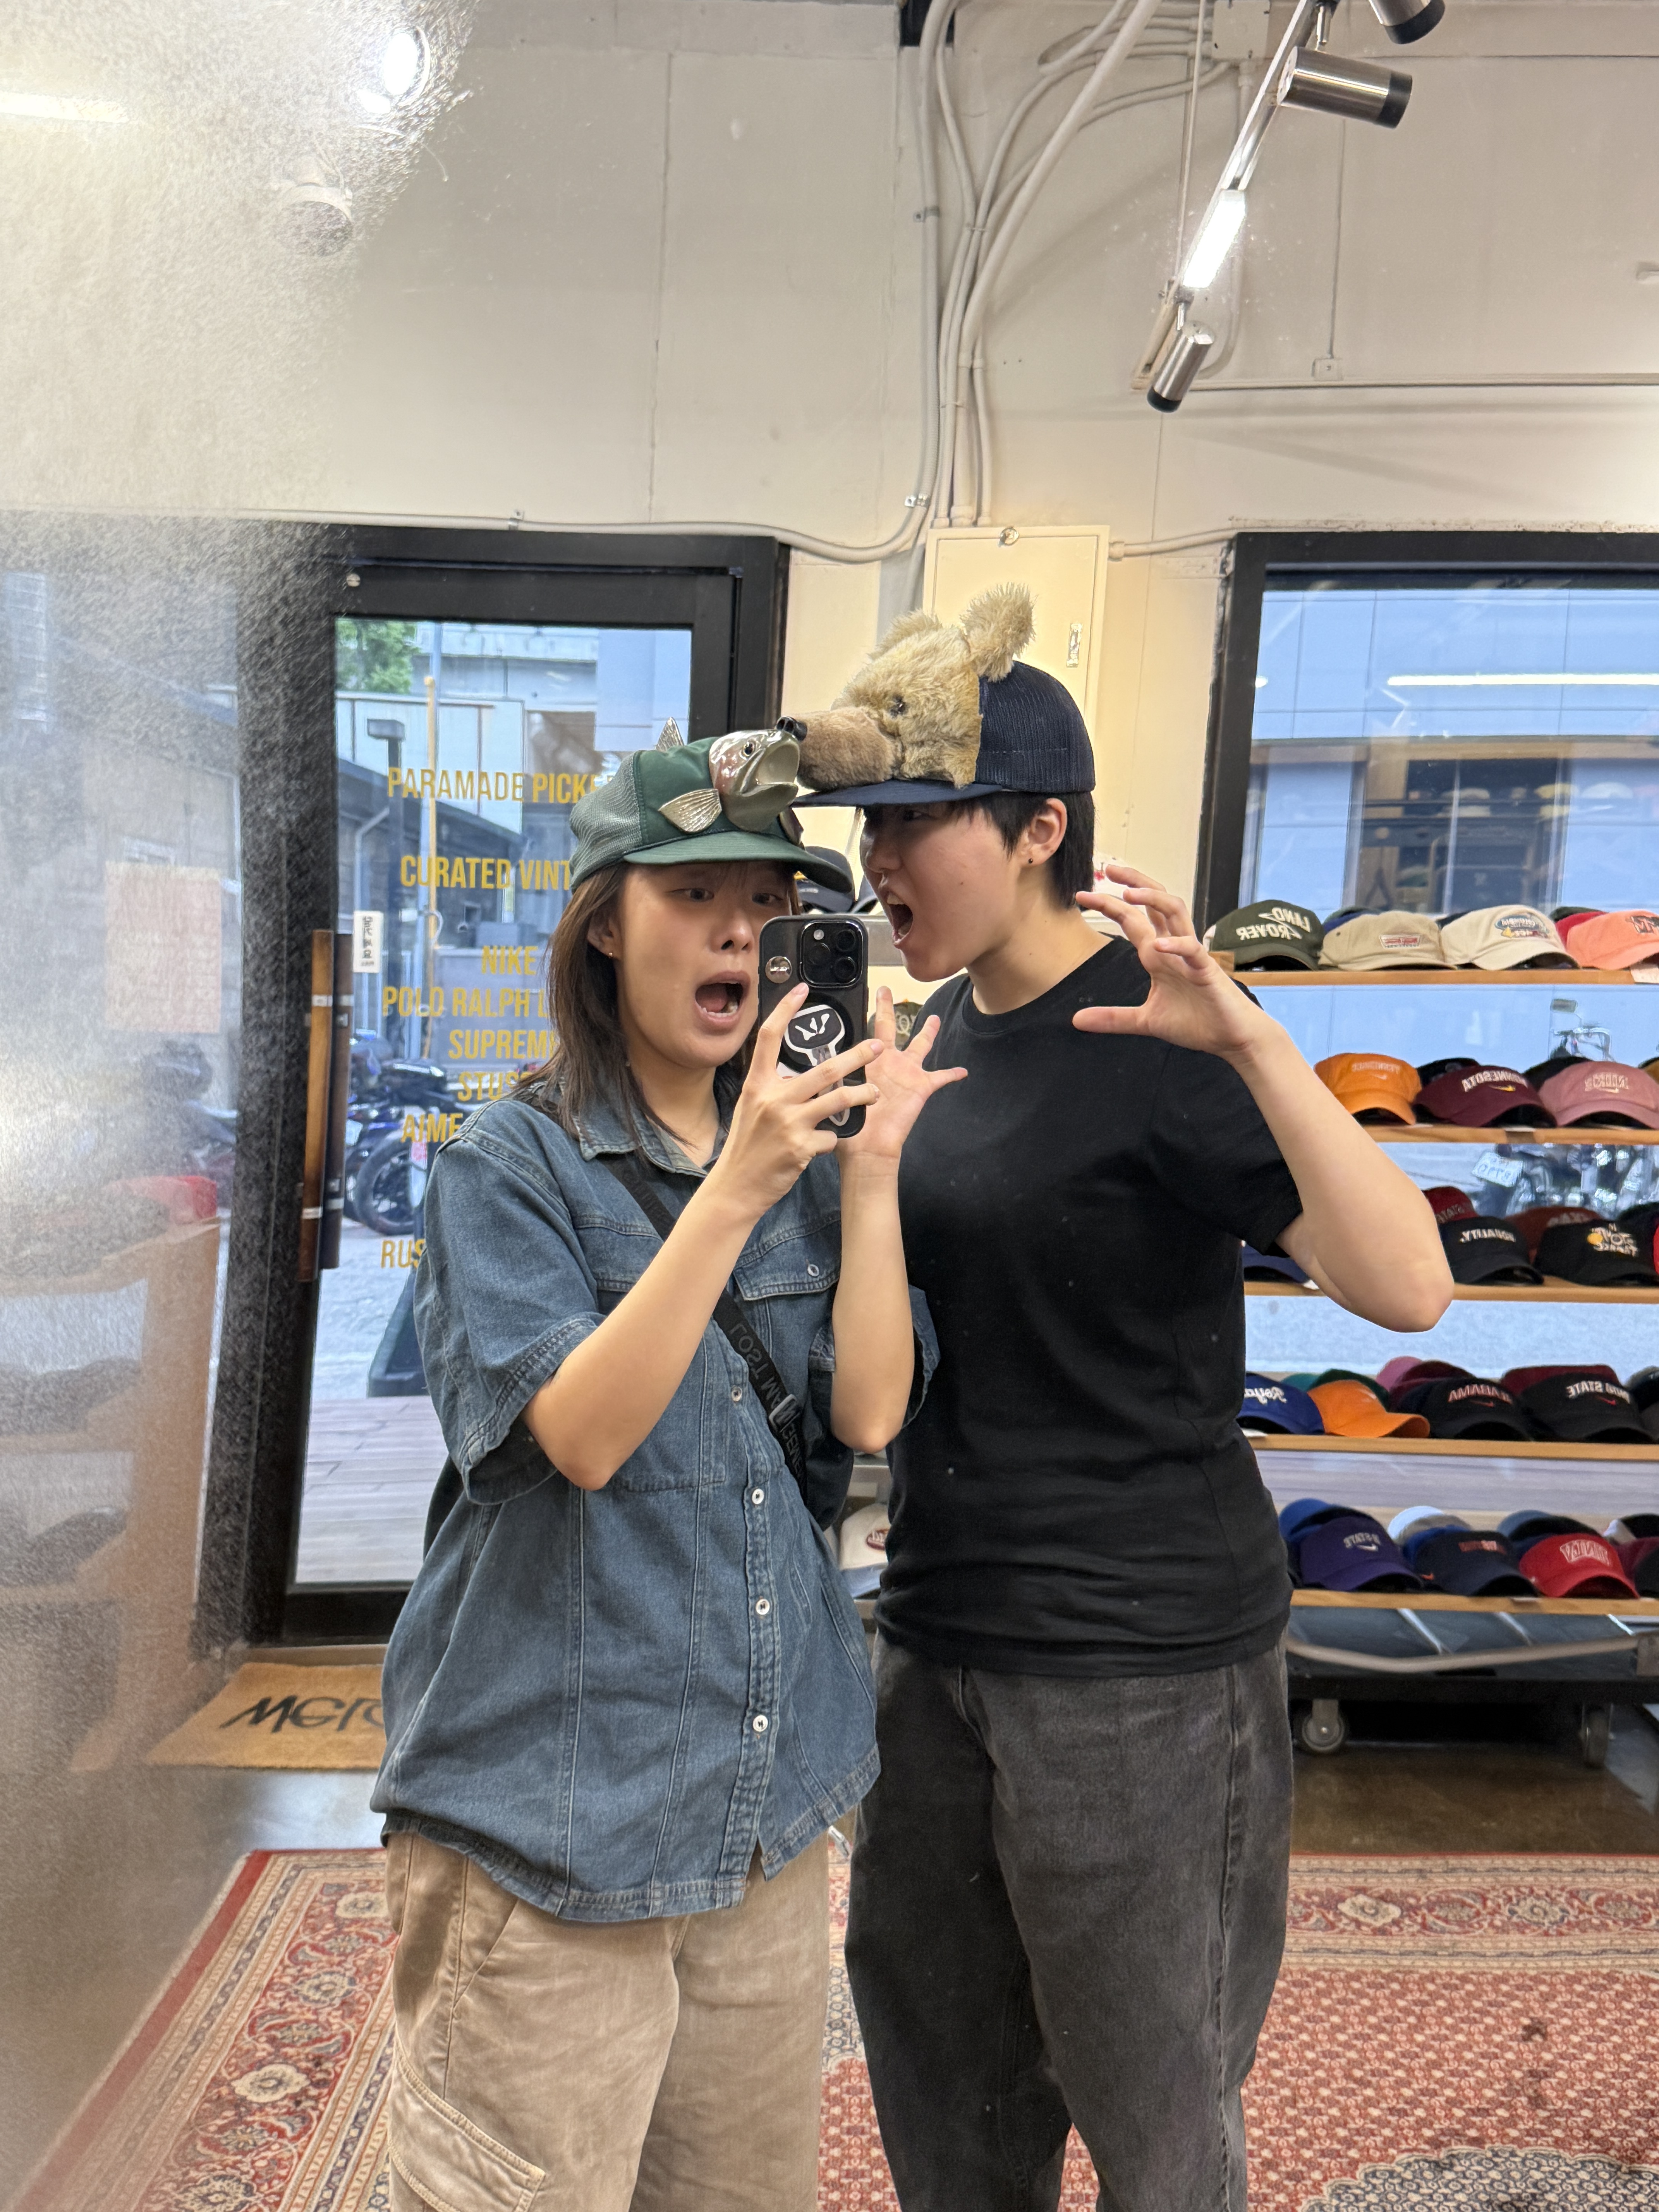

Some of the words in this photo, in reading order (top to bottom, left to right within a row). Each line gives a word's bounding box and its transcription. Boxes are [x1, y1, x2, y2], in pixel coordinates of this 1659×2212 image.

[388, 767, 524, 802] PARAMADE
[532, 773, 614, 804] PICK
[401, 855, 512, 890] CURATED
[481, 945, 538, 975] NIKE
[382, 986, 444, 1017] POLO
[452, 987, 530, 1018] RALPH
[457, 1071, 534, 1101] STUS
